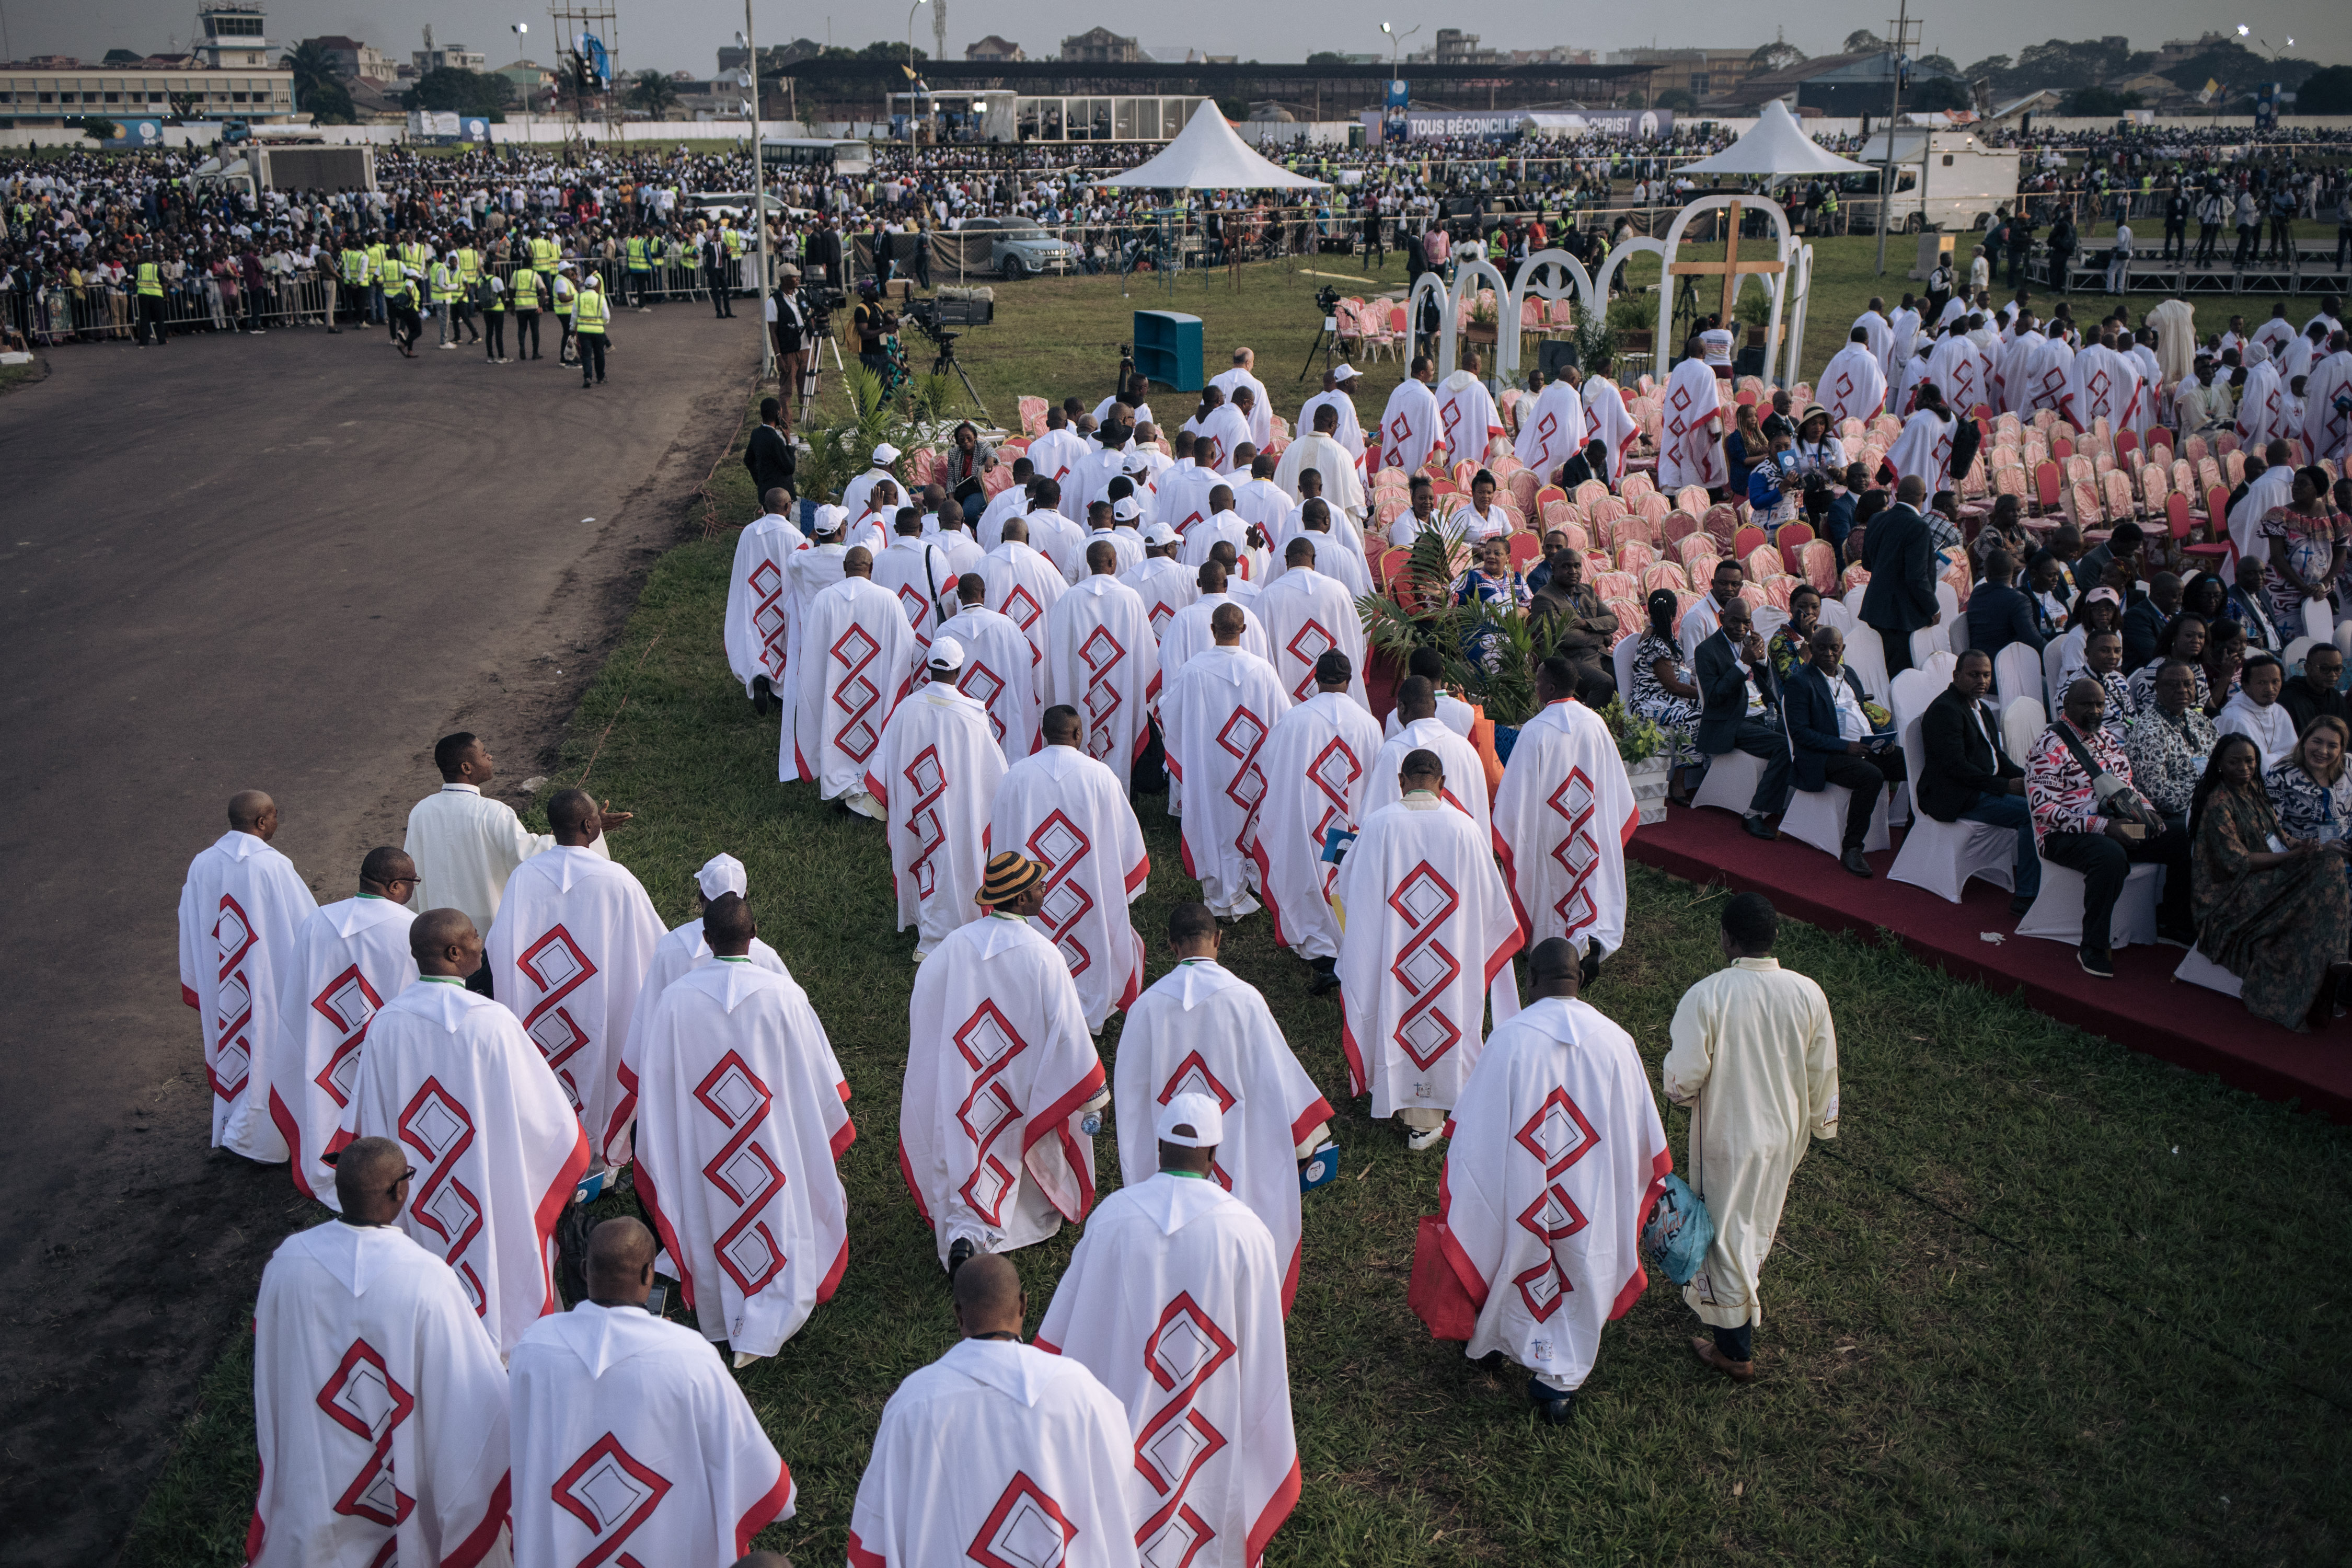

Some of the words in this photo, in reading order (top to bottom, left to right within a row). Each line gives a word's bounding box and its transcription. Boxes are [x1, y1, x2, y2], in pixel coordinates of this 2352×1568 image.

[1411, 119, 1445, 135] TOUS
[1447, 114, 1523, 134] RÉCONCILIÉ
[1589, 117, 1631, 132] CHRIST
